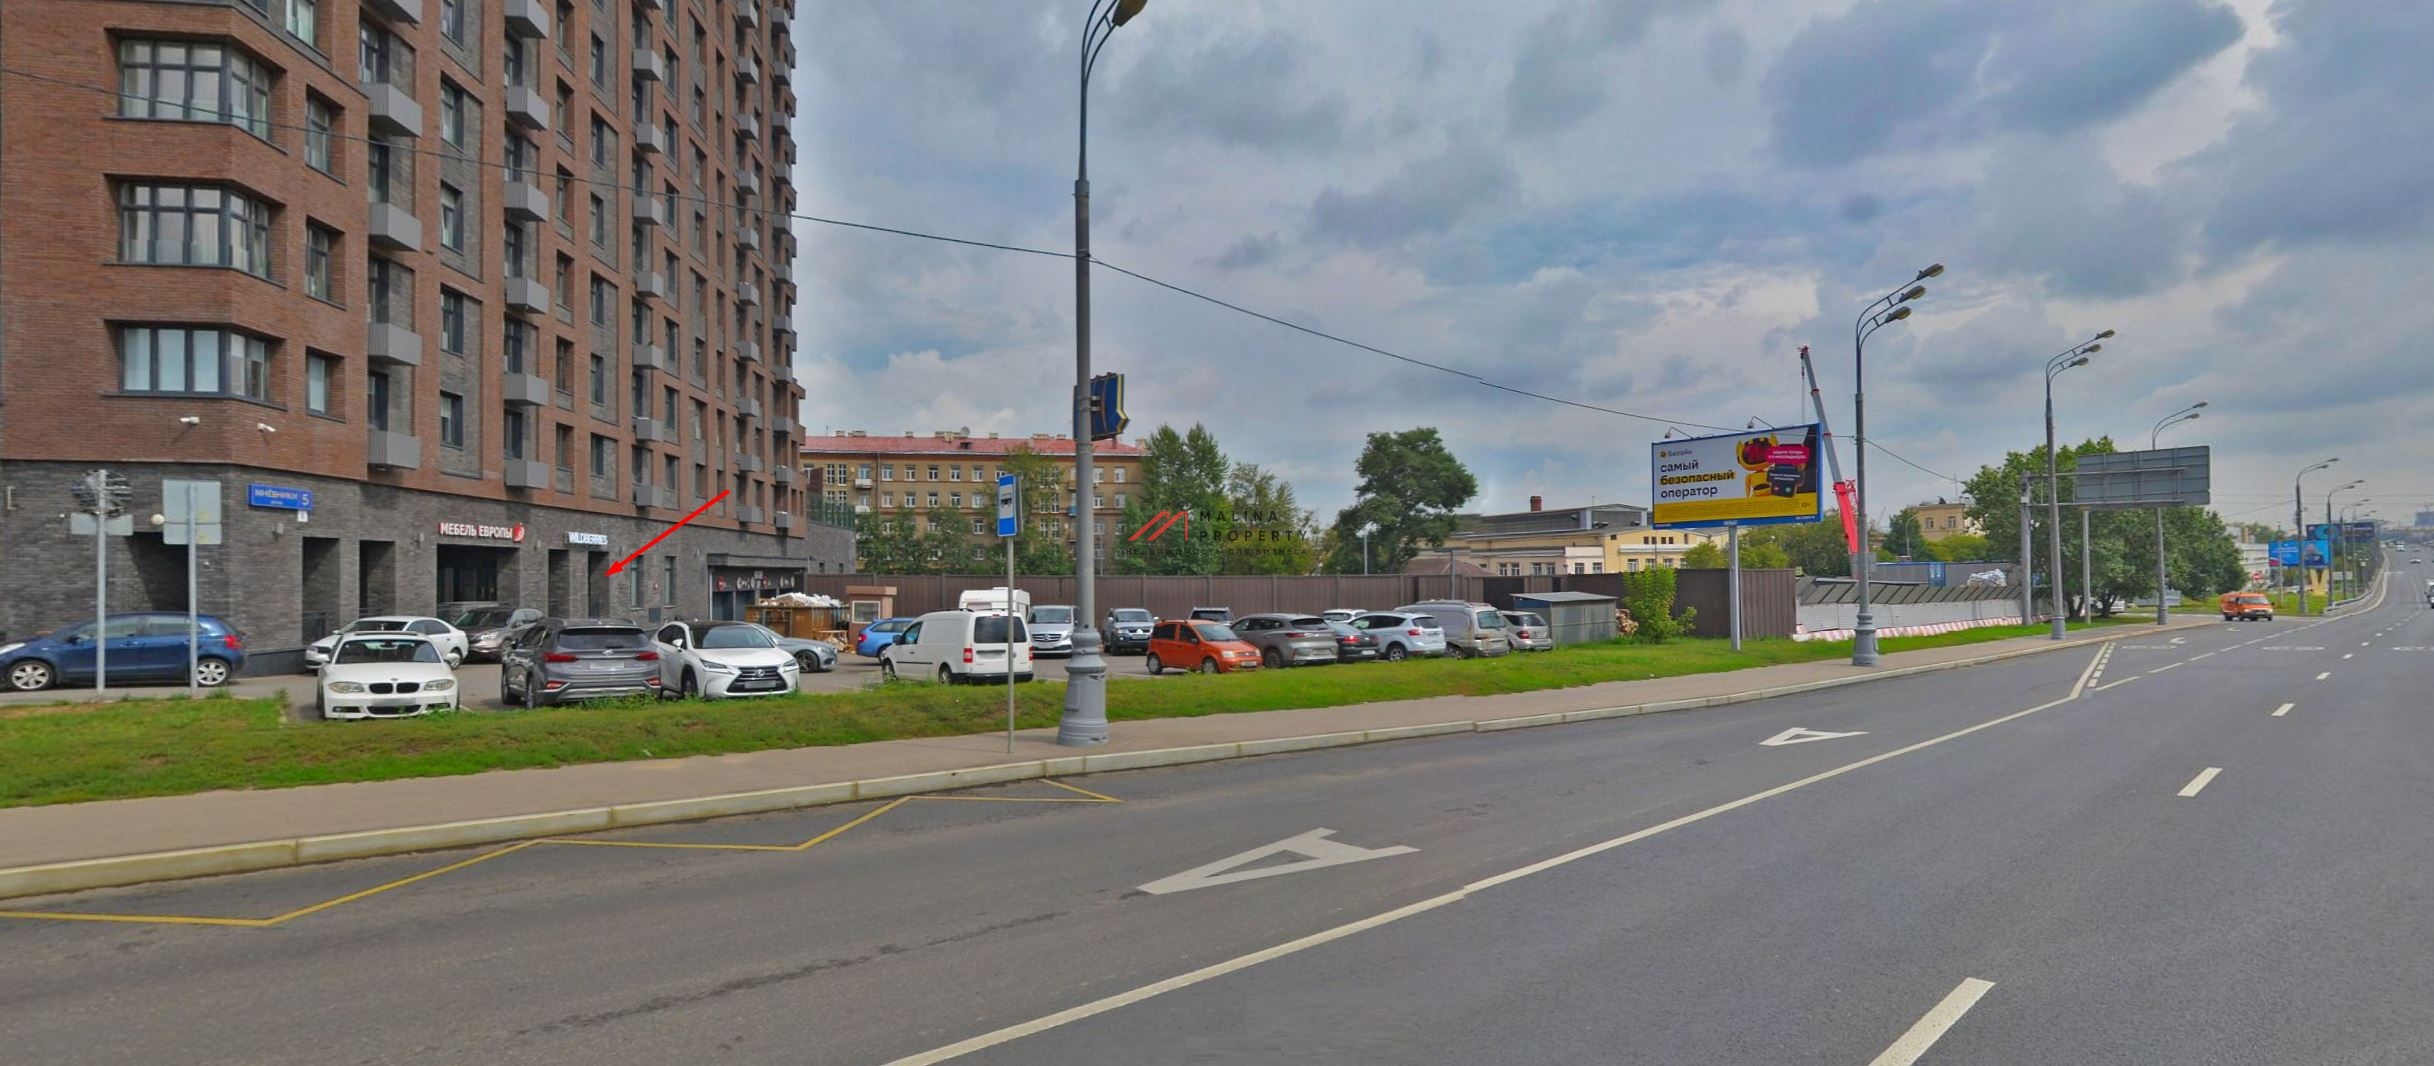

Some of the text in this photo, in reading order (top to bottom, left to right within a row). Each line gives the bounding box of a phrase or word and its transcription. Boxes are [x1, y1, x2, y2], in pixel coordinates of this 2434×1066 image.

[1660, 459, 1699, 473] самый
[1660, 469, 1735, 486] безопасный
[301, 493, 310, 506] 5
[1660, 485, 1718, 500] оператор
[439, 521, 513, 539] МЕБЕЛЬ ЕВРОПЫ
